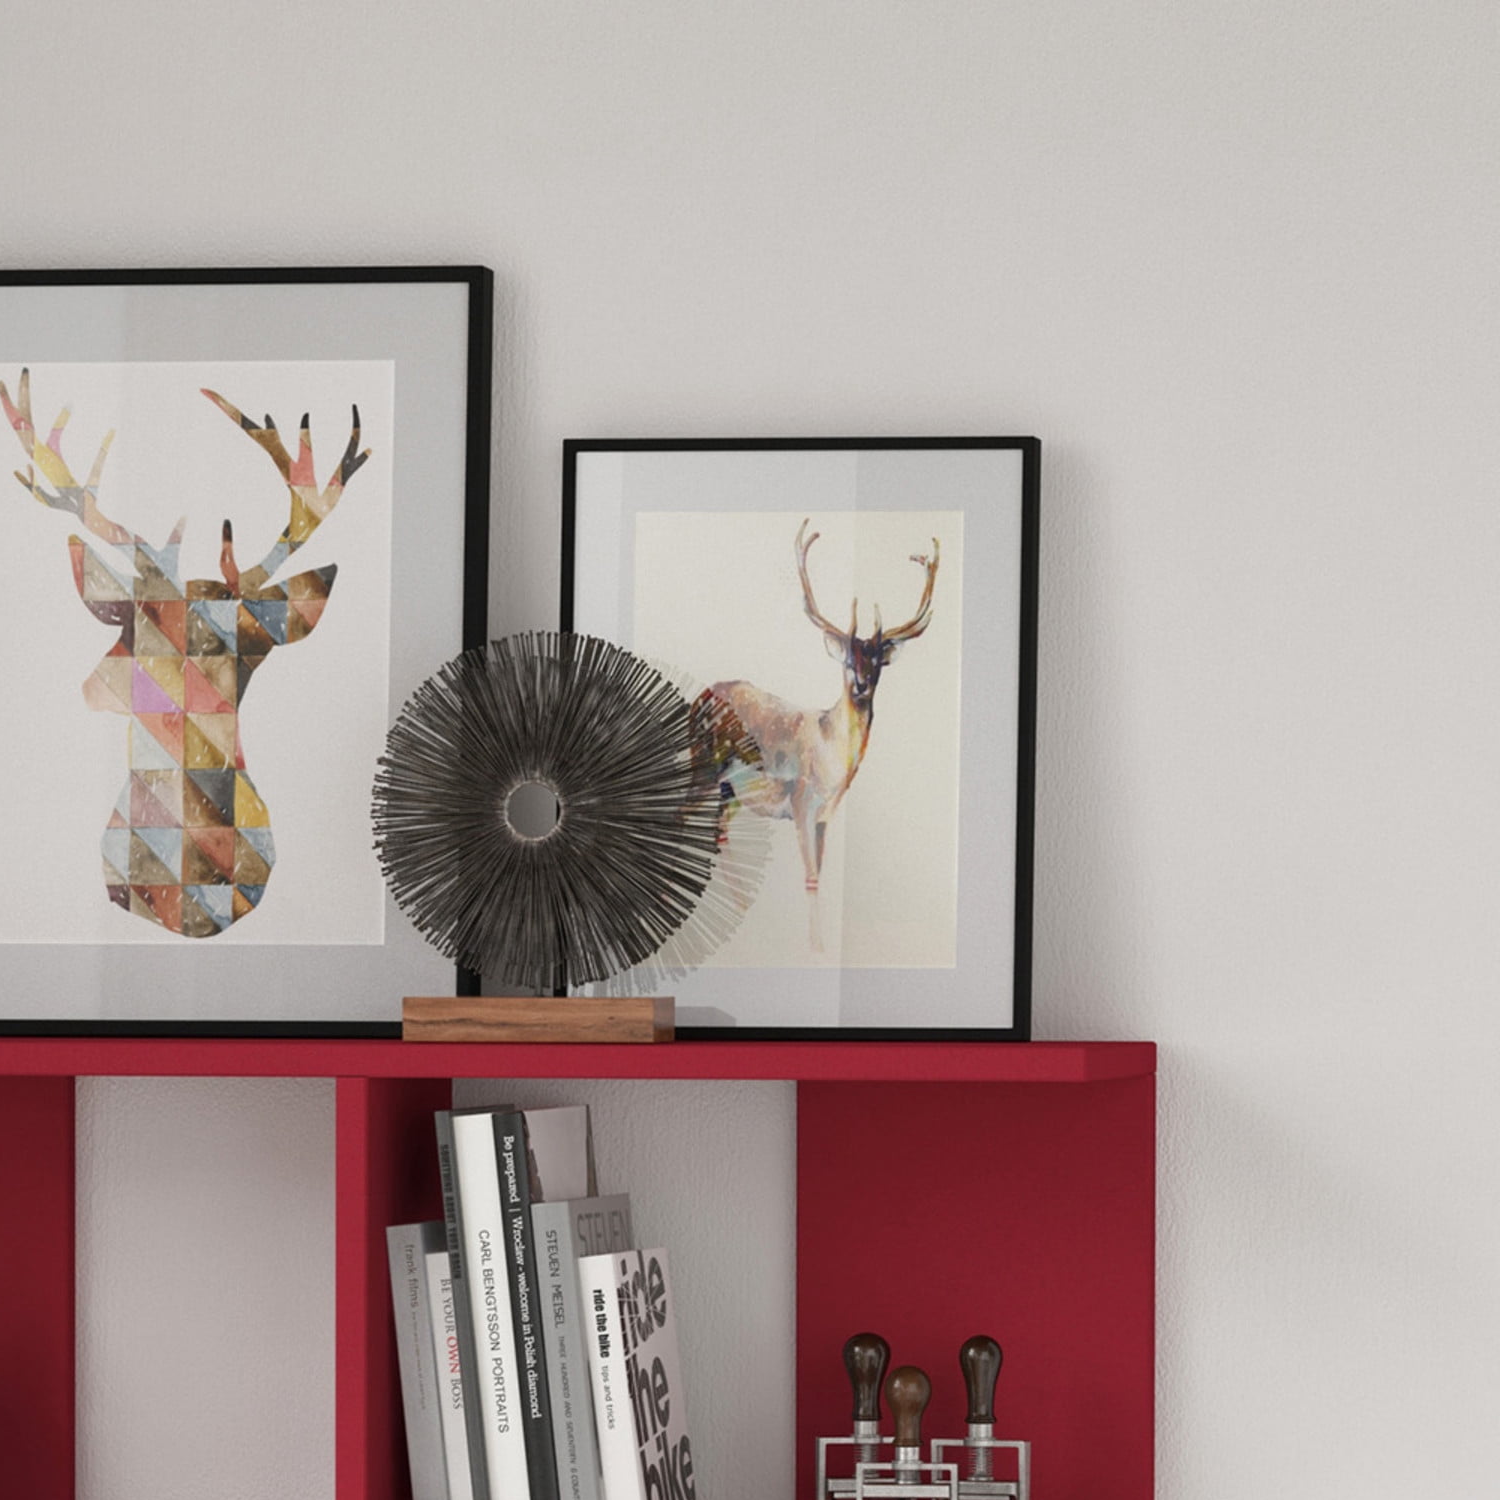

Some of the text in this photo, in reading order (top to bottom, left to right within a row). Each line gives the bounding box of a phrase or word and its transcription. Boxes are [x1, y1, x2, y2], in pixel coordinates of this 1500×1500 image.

[503, 1136, 515, 1150] Be
[503, 1152, 521, 1203] prepared
[405, 1244, 415, 1274] frank
[546, 1229, 560, 1277] STEVEN
[408, 1277, 419, 1307] films
[518, 1273, 530, 1322] welcome
[552, 1285, 565, 1328] MEISEL
[593, 1289, 607, 1313] ride
[443, 1297, 457, 1334] YOUR
[522, 1324, 533, 1335] in
[596, 1313, 608, 1333] the
[479, 1230, 509, 1433] CARL BENGTSSON PORTRAITS
[598, 1334, 611, 1358] bike
[446, 1336, 461, 1374] OWN
[524, 1336, 537, 1368] Polish
[451, 1378, 463, 1409] BOSS
[527, 1369, 542, 1419] diamond
[604, 1384, 612, 1402] and
